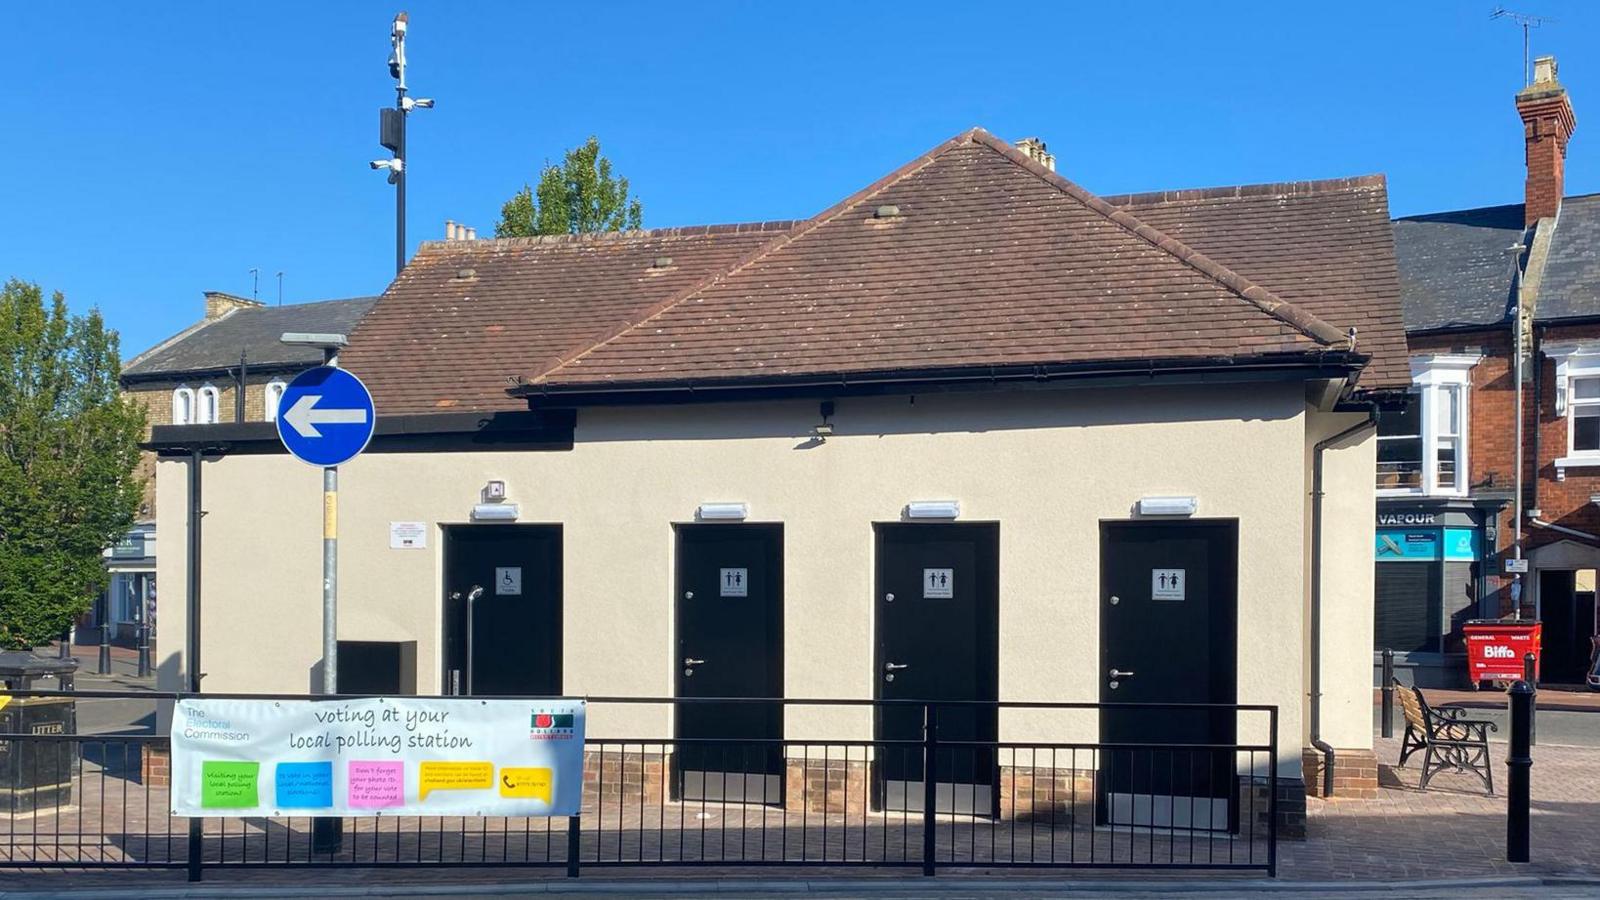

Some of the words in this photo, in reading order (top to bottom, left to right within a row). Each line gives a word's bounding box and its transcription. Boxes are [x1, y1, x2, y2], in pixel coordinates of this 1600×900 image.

[1379, 514, 1435, 524] VAPOUR
[1484, 645, 1515, 658] Biffa
[187, 707, 205, 718] The
[314, 704, 375, 728] voting
[382, 707, 400, 722] at
[406, 709, 449, 731] your
[32, 723, 63, 735] LITTER
[186, 719, 231, 729] Electoral
[184, 728, 250, 741] Commission
[289, 732, 331, 748] local
[336, 728, 402, 754] polling
[407, 729, 473, 749] station
